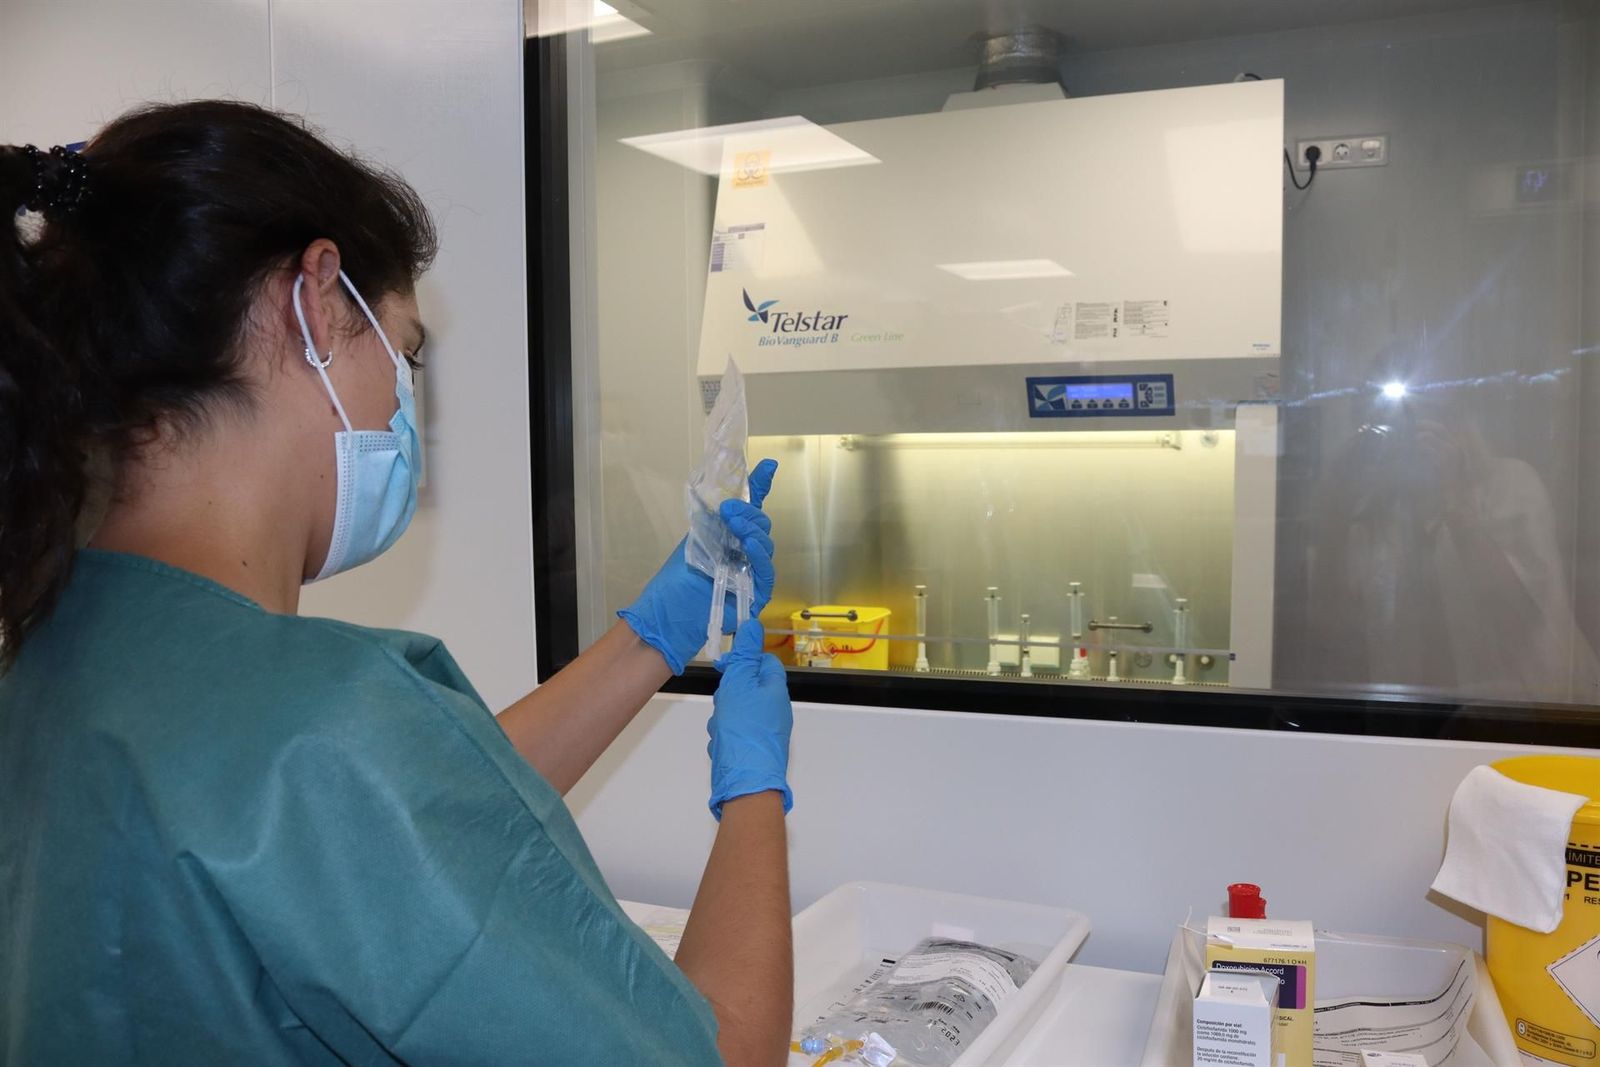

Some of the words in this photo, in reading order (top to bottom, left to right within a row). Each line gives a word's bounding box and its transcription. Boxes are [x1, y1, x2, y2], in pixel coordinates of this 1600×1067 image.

[770, 310, 848, 334] Telstar
[758, 333, 828, 347] BioVanguard
[830, 333, 839, 343] B
[851, 332, 881, 343] Green
